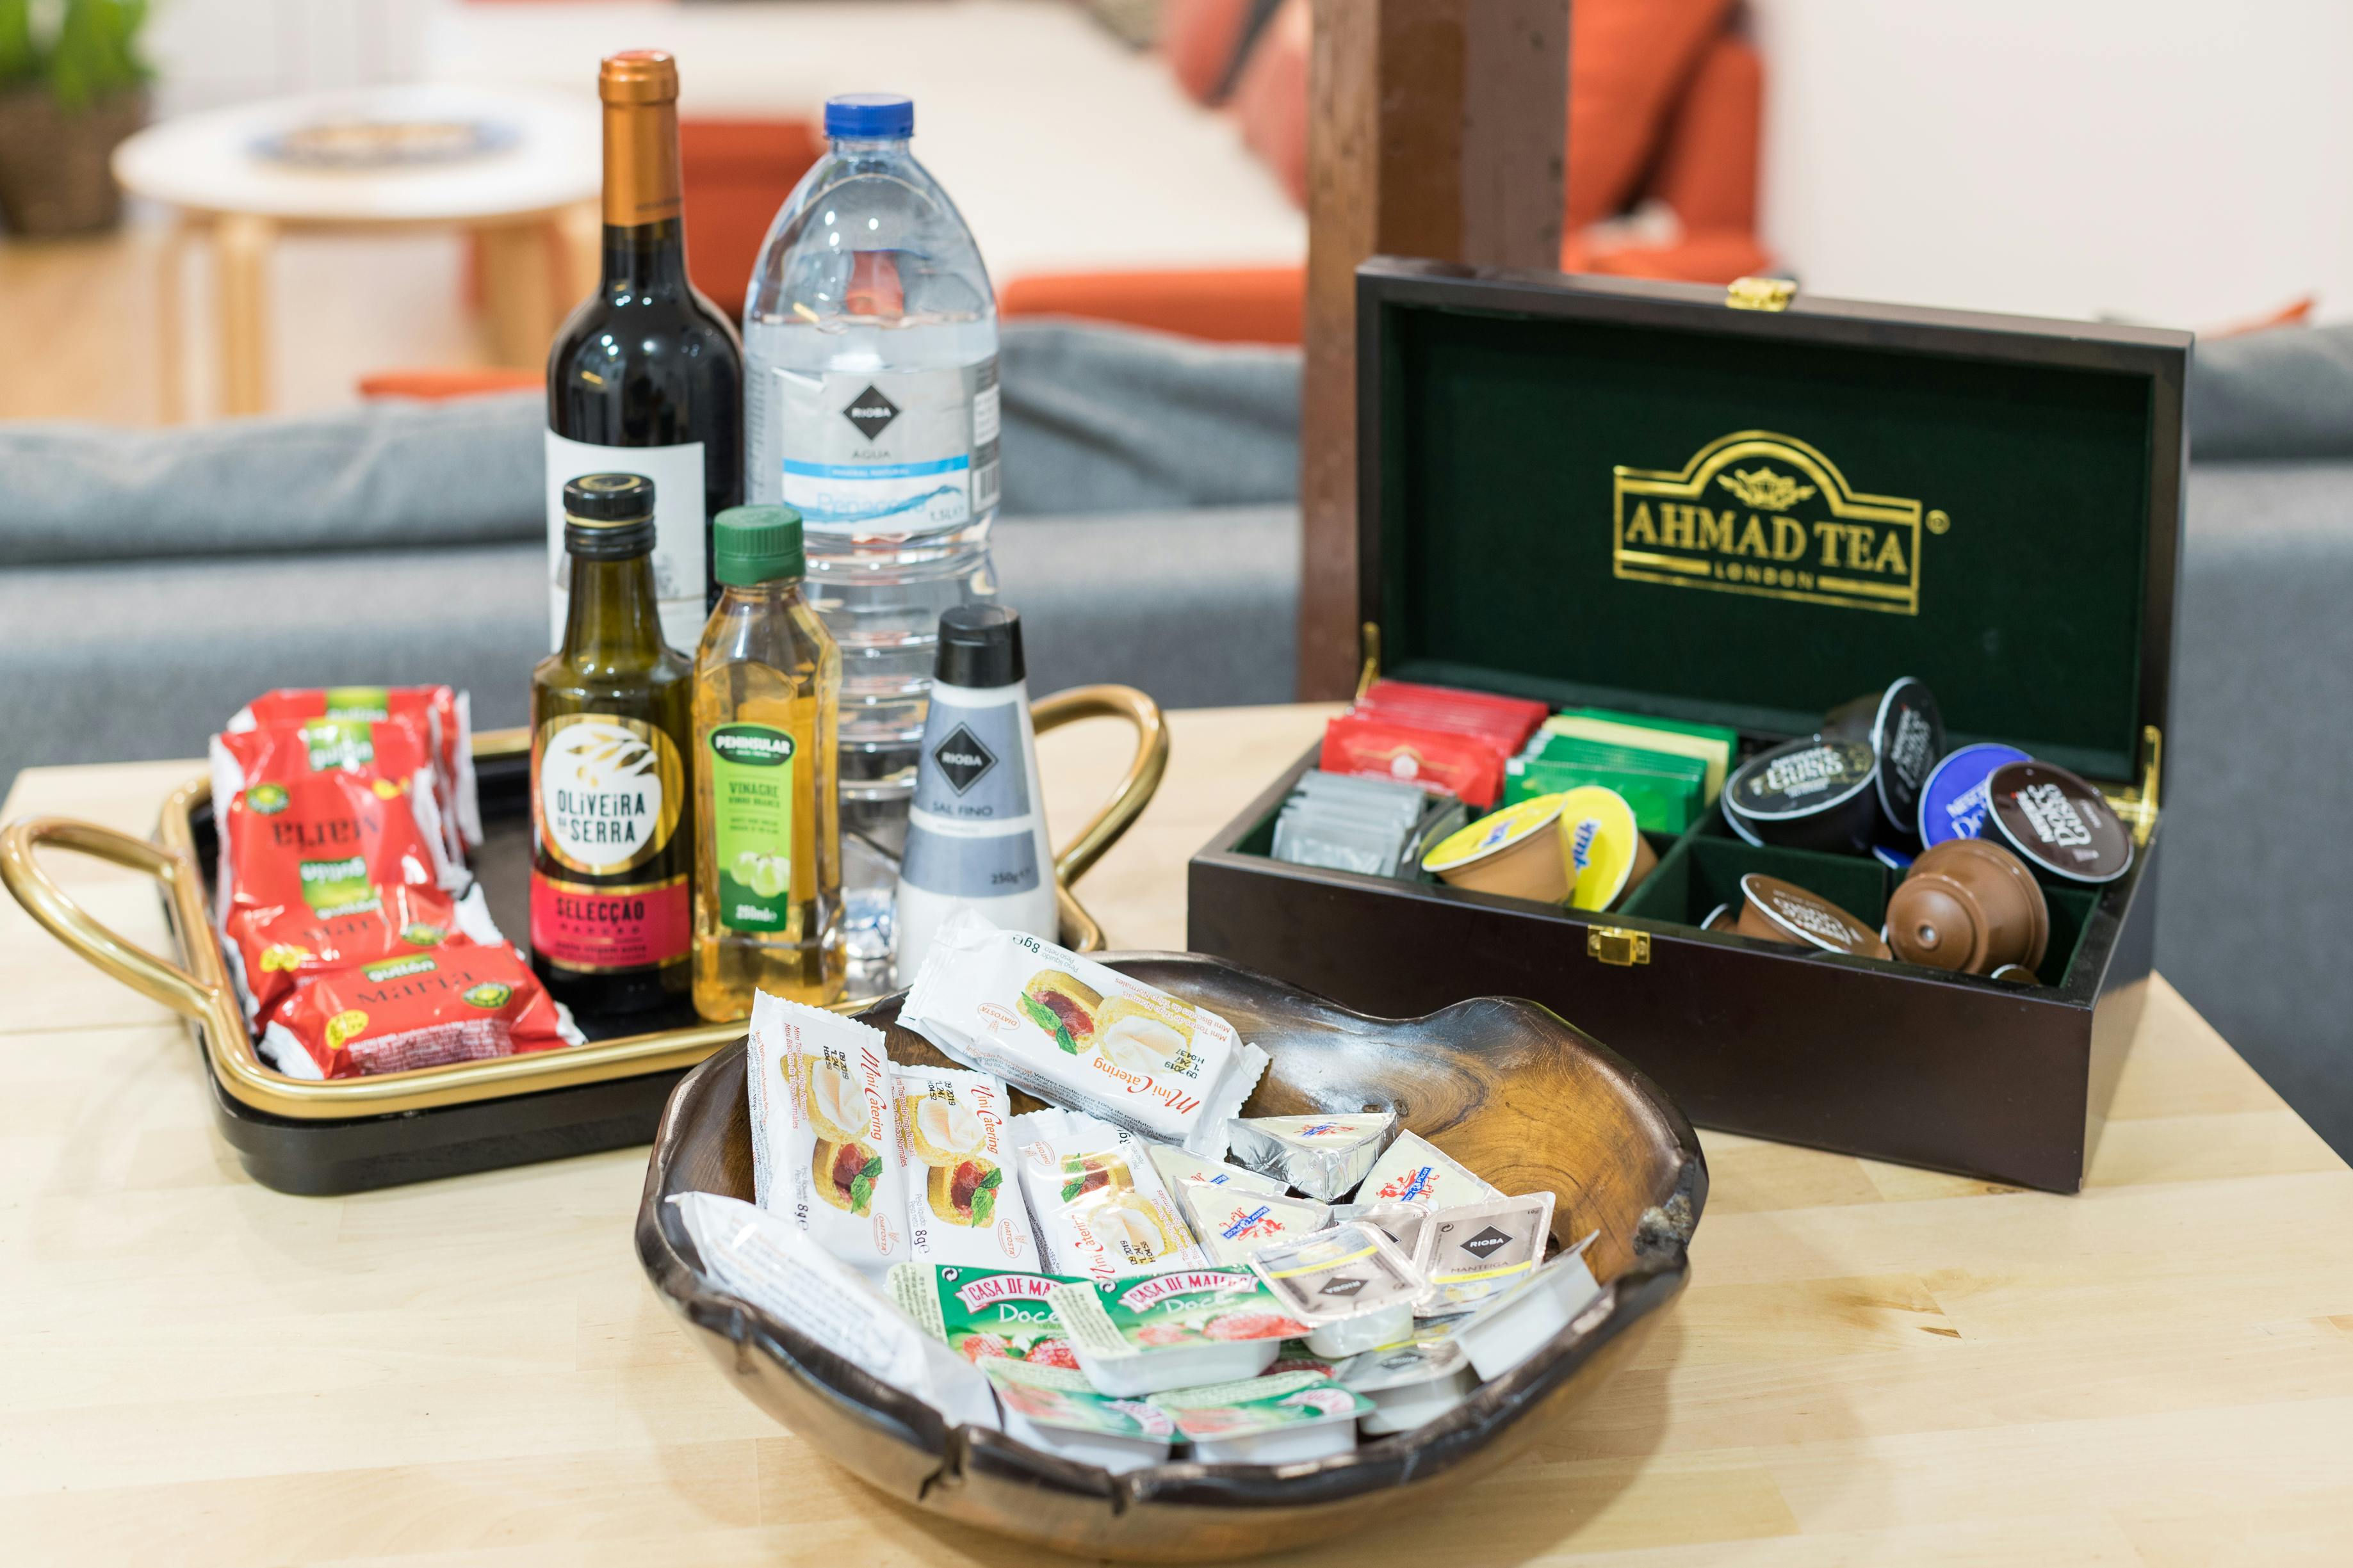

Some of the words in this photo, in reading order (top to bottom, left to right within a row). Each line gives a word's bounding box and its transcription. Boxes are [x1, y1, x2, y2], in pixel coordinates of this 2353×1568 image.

[851, 407, 892, 418] RIOBA
[1625, 500, 1807, 562] AHMAD
[1813, 521, 1909, 575] TEA
[1715, 561, 1814, 590] LONDON
[715, 735, 791, 755] PENINSULAR
[941, 752, 983, 766] RIOBA
[728, 782, 779, 798] VINAGRE
[933, 802, 953, 814] SAL
[957, 805, 993, 816] FINO
[571, 821, 635, 843] SERRA
[557, 896, 645, 925] SELECÇÃO
[1059, 952, 1075, 964] Peso
[1063, 961, 1079, 973] Peso
[1113, 974, 1151, 1000] Normales
[1120, 988, 1153, 1011] Normais
[1150, 991, 1173, 1008] Trigo
[1171, 1002, 1182, 1012] de
[1152, 1002, 1175, 1020] Trigo
[1173, 1014, 1185, 1024] de
[1181, 1005, 1214, 1028] Biscotes
[783, 1022, 792, 1037] Mini
[792, 1025, 801, 1040] Mini
[1184, 1017, 1209, 1035] Tostas
[1209, 1028, 1227, 1042] Mini
[1212, 1020, 1231, 1034] Mini
[785, 1037, 795, 1065] Biscotes
[795, 1041, 804, 1061] Tostas
[788, 1065, 796, 1075] de
[797, 1062, 804, 1071] de
[1164, 1060, 1185, 1075] 2019
[1174, 1055, 1191, 1067] 247
[840, 1062, 849, 1080] 2019
[861, 1046, 881, 1095] Mini
[1094, 1057, 1158, 1094] Catering
[1185, 1069, 1198, 1079] 09
[787, 1076, 798, 1094] Trigo
[797, 1072, 806, 1090] Trigo
[897, 1085, 907, 1104] Tostas
[936, 1086, 946, 1101] 247
[945, 1088, 957, 1106] 2019
[1033, 1072, 1057, 1086] Valores
[1096, 1101, 1113, 1111] 100g
[1151, 1083, 1200, 1115] Mini
[787, 1095, 802, 1129] Normales
[797, 1090, 810, 1121] Normais
[864, 1087, 886, 1142] Catering
[901, 1106, 907, 1114] de
[901, 1115, 911, 1131] Trigo
[977, 1106, 1002, 1155] Catering
[896, 1138, 908, 1167] Normales
[906, 1132, 915, 1157] Normais
[1415, 1167, 1431, 1184] Picot
[908, 1200, 917, 1215] Peso
[915, 1193, 923, 1206] Peso
[1150, 1196, 1168, 1221] Normais
[1156, 1188, 1174, 1215] Normales
[1162, 1218, 1176, 1235] Trigo
[1225, 1224, 1241, 1238] Picot
[1120, 1238, 1133, 1256] 2019
[1131, 1241, 1143, 1256] 247
[1176, 1241, 1190, 1261] Tostas
[1182, 1234, 1200, 1260] Biscotes
[1470, 1238, 1504, 1248] RIOBA
[1128, 1254, 1137, 1266] 09
[1451, 1261, 1509, 1273] MANTEIGA
[968, 1279, 1004, 1300] CASA
[1005, 1277, 1024, 1294] DE
[1130, 1282, 1165, 1302] CASA
[1166, 1278, 1183, 1291] DE
[1324, 1281, 1361, 1293] RIOBA
[1164, 1294, 1235, 1313] Doce
[998, 1304, 1059, 1323] Doce
